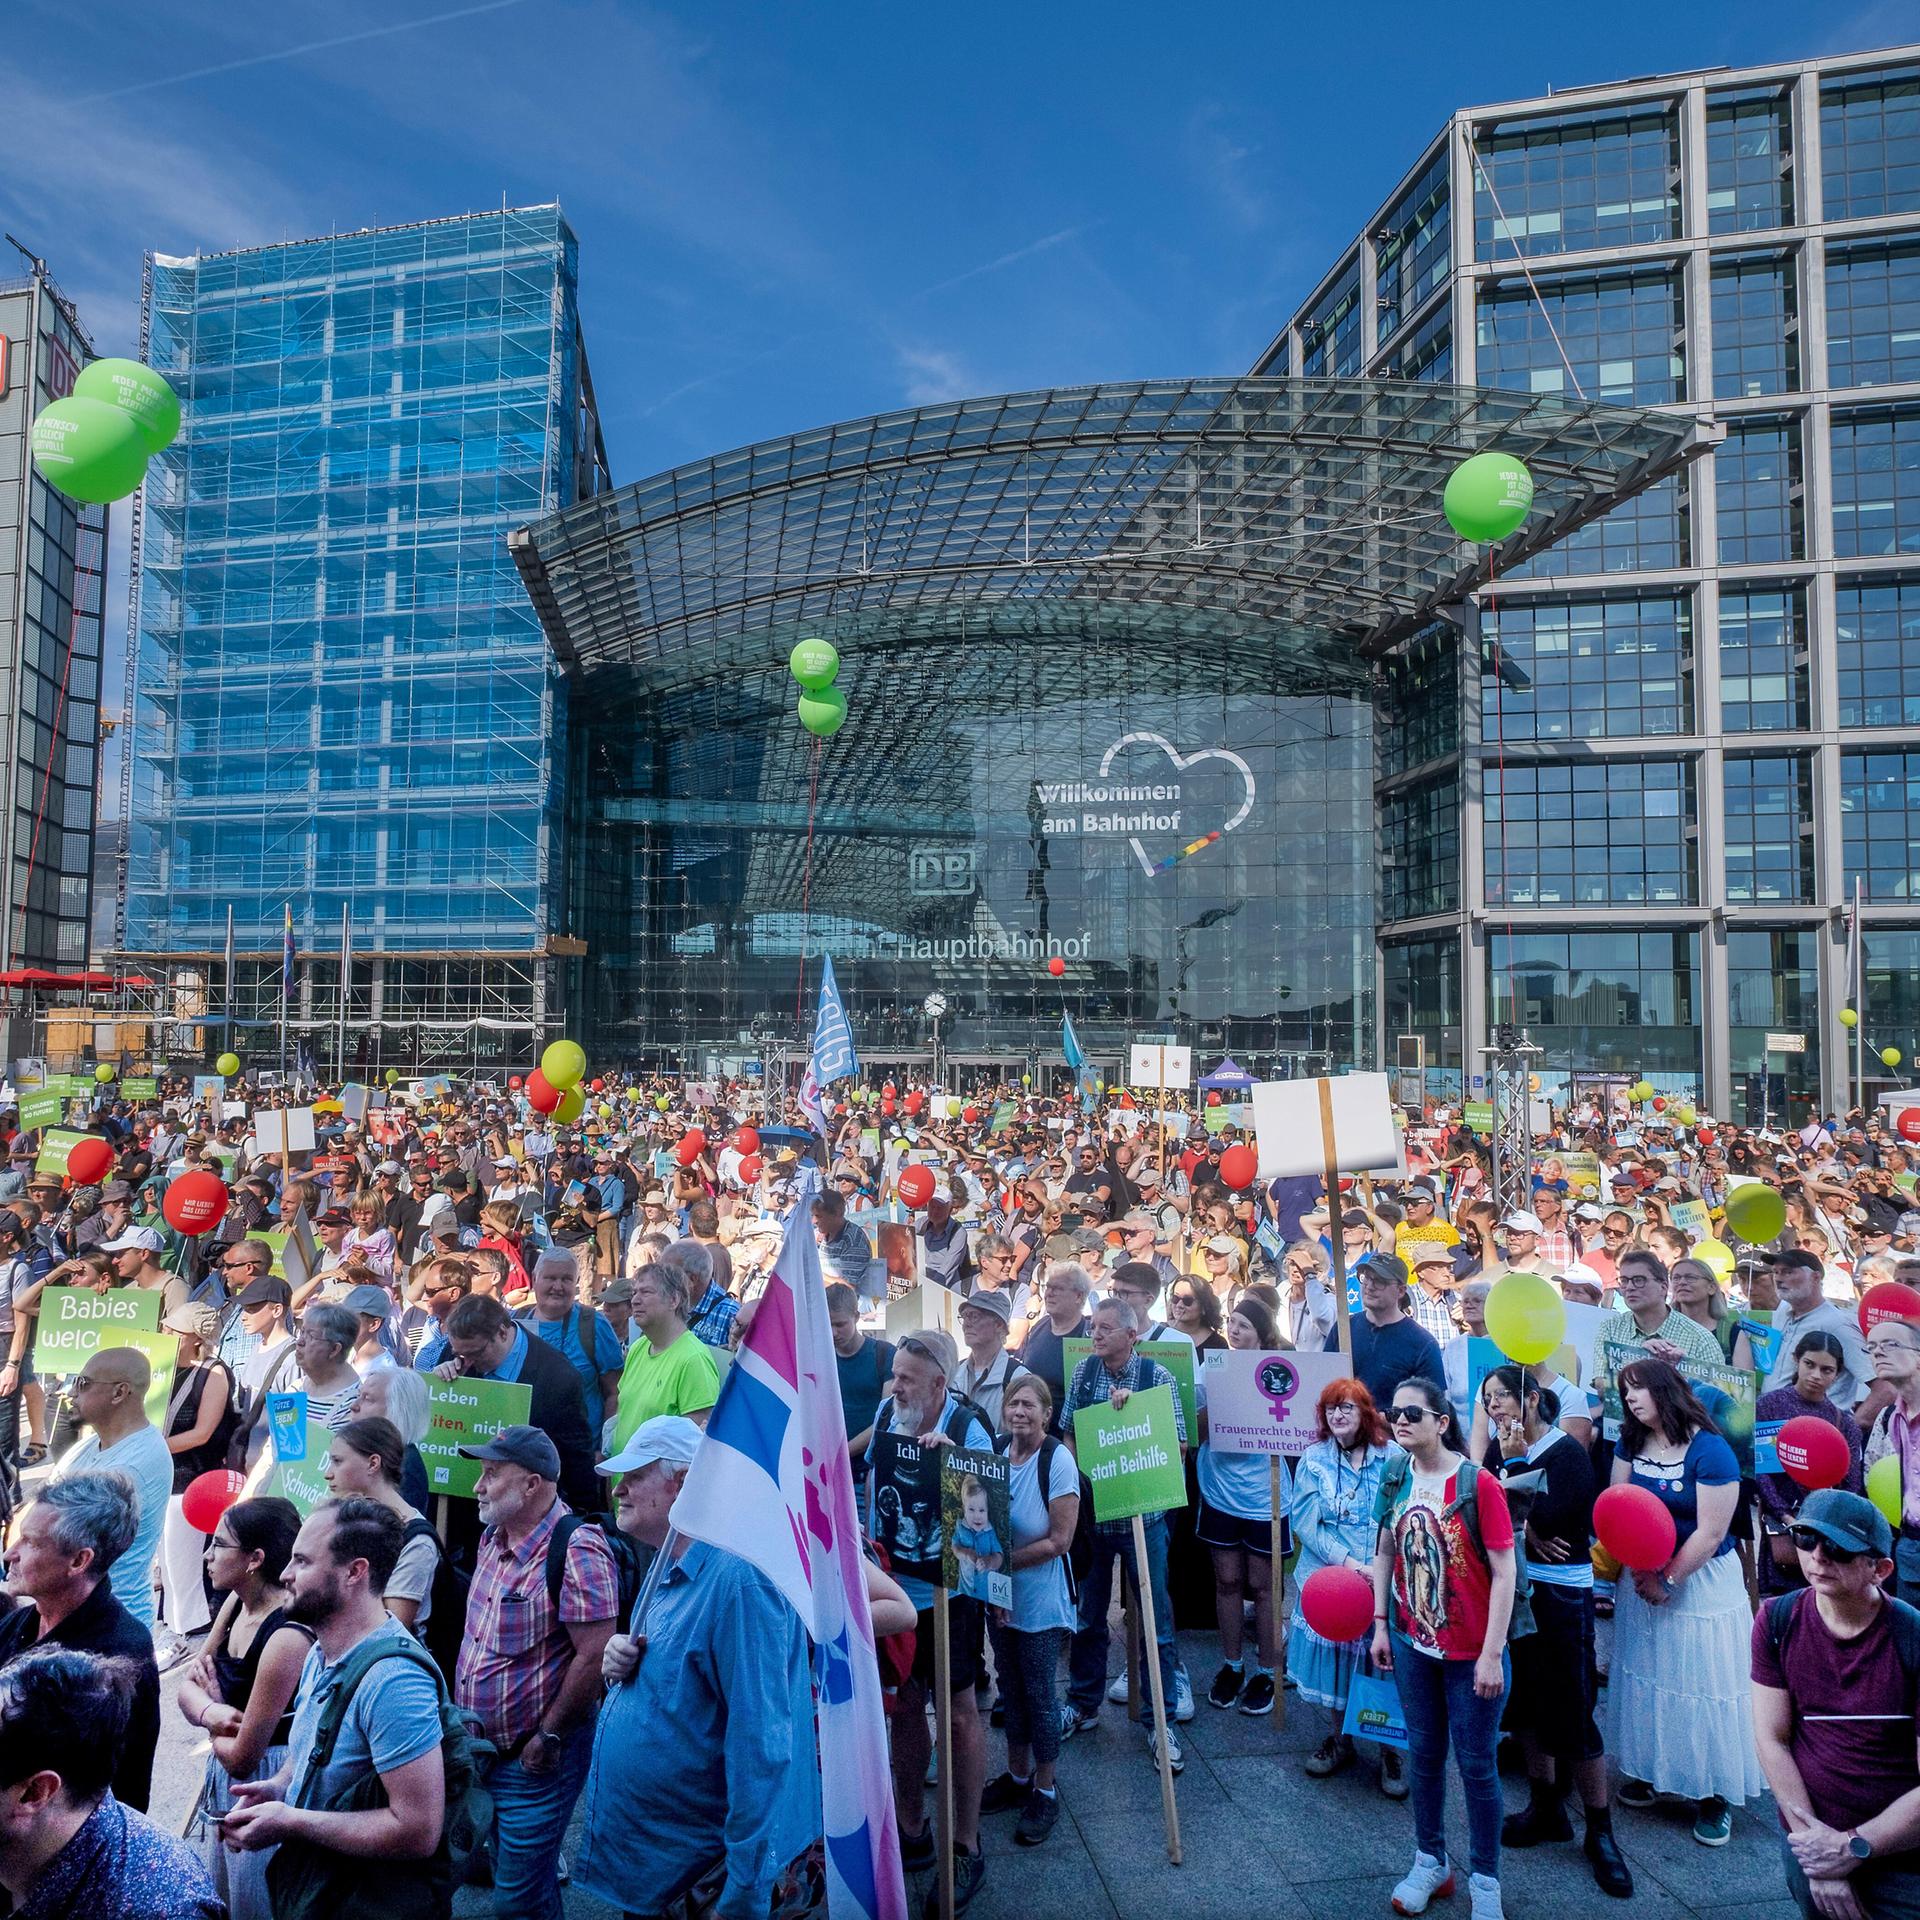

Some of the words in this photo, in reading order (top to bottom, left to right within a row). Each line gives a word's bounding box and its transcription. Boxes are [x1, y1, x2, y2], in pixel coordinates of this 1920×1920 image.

[1036, 783, 1181, 804] Willkommen
[1042, 817, 1076, 833] am
[1082, 810, 1181, 832] Bahnhof
[919, 855, 968, 888] DB
[898, 931, 1091, 964] Hauptbahnhof
[60, 1295, 139, 1320] Babies
[429, 1385, 479, 1406] Leben
[1098, 1414, 1152, 1449] Beistand
[1214, 1424, 1291, 1437] Frauenrechte
[1294, 1427, 1317, 1440] beg
[896, 1443, 921, 1462] Ich!
[1239, 1438, 1254, 1449] im
[1787, 1445, 1808, 1456] LIEBEN
[946, 1454, 978, 1475] Auch
[981, 1460, 1005, 1481] ich!
[1091, 1459, 1117, 1483] statt
[1119, 1443, 1169, 1476] Beihilfe
[991, 1581, 1009, 1598] BVL
